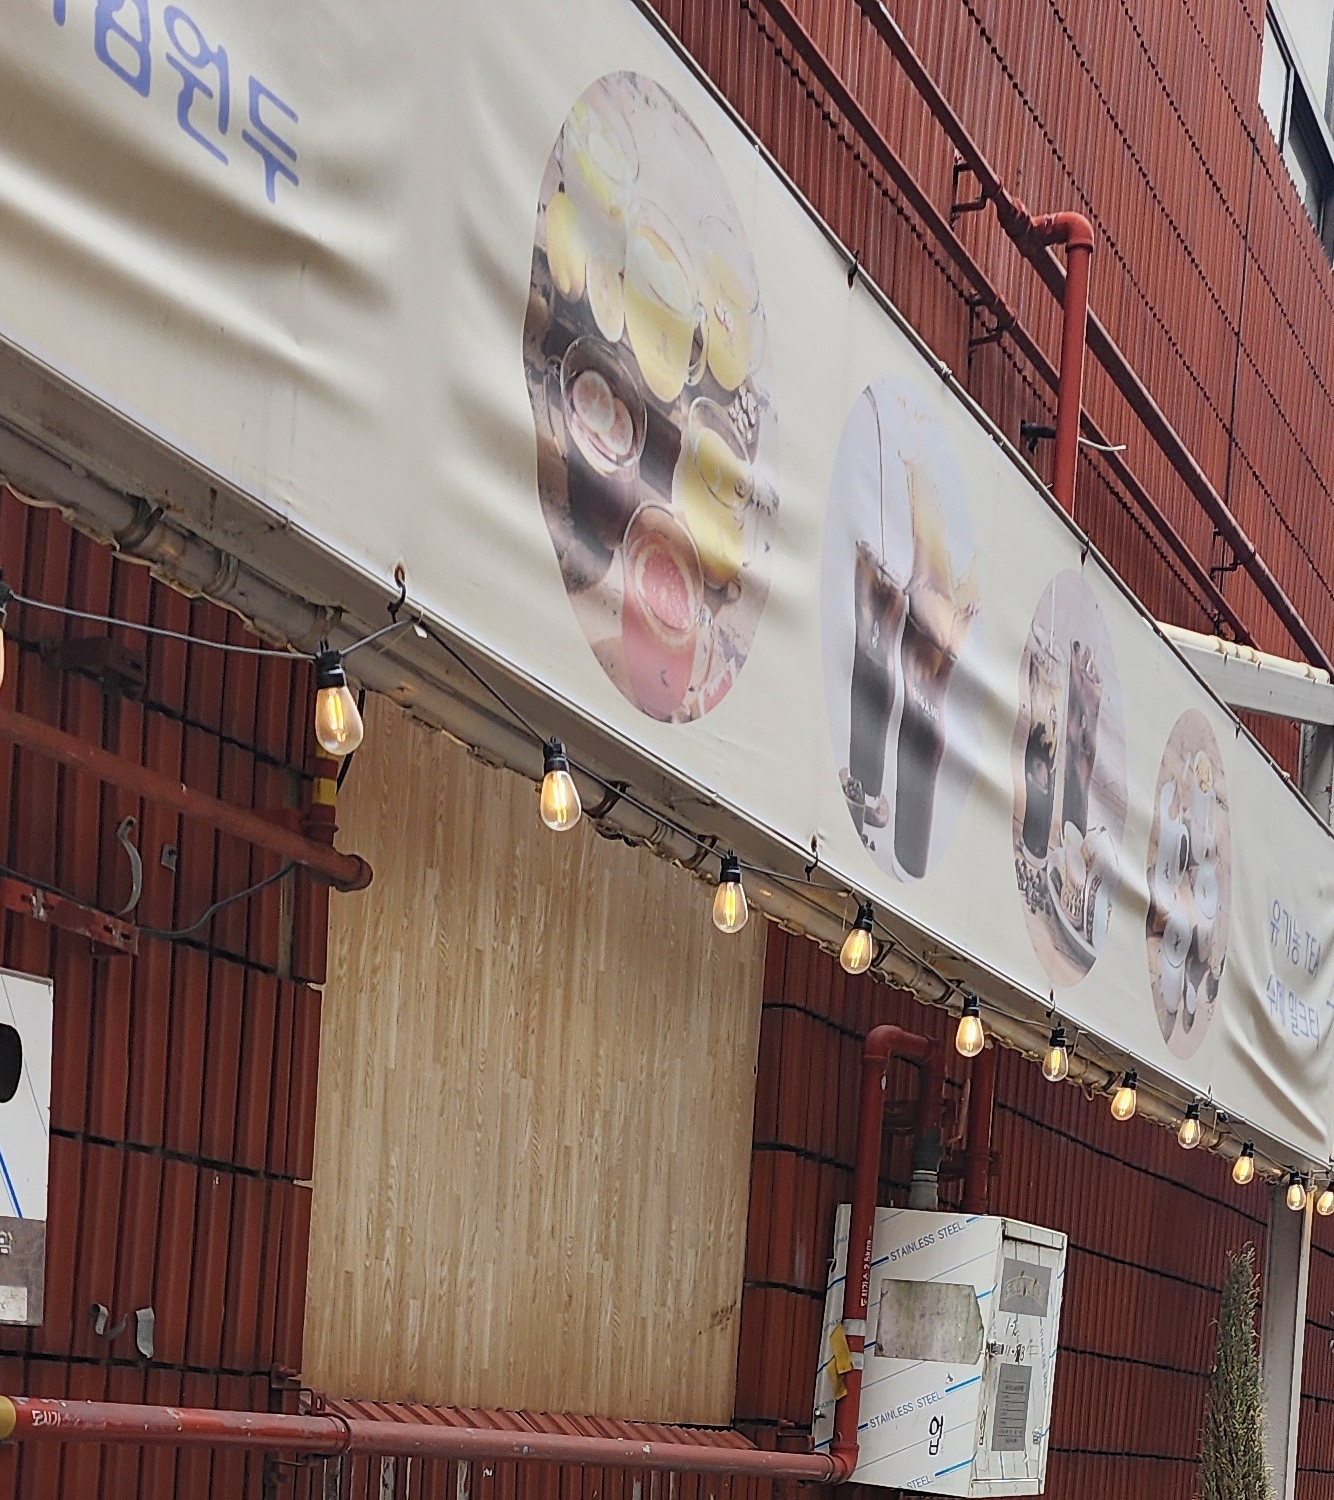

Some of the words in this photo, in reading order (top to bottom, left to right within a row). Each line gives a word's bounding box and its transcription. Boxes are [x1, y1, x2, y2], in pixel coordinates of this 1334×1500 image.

[1270, 900, 1301, 965] 유기농
[1304, 931, 1322, 979] TEA
[1287, 991, 1321, 1050] 밀크티
[890, 1233, 935, 1261] STAINLESS
[937, 1222, 964, 1240] STEEL
[869, 1402, 914, 1429] STAINLESS
[916, 1391, 944, 1409] STEEL
